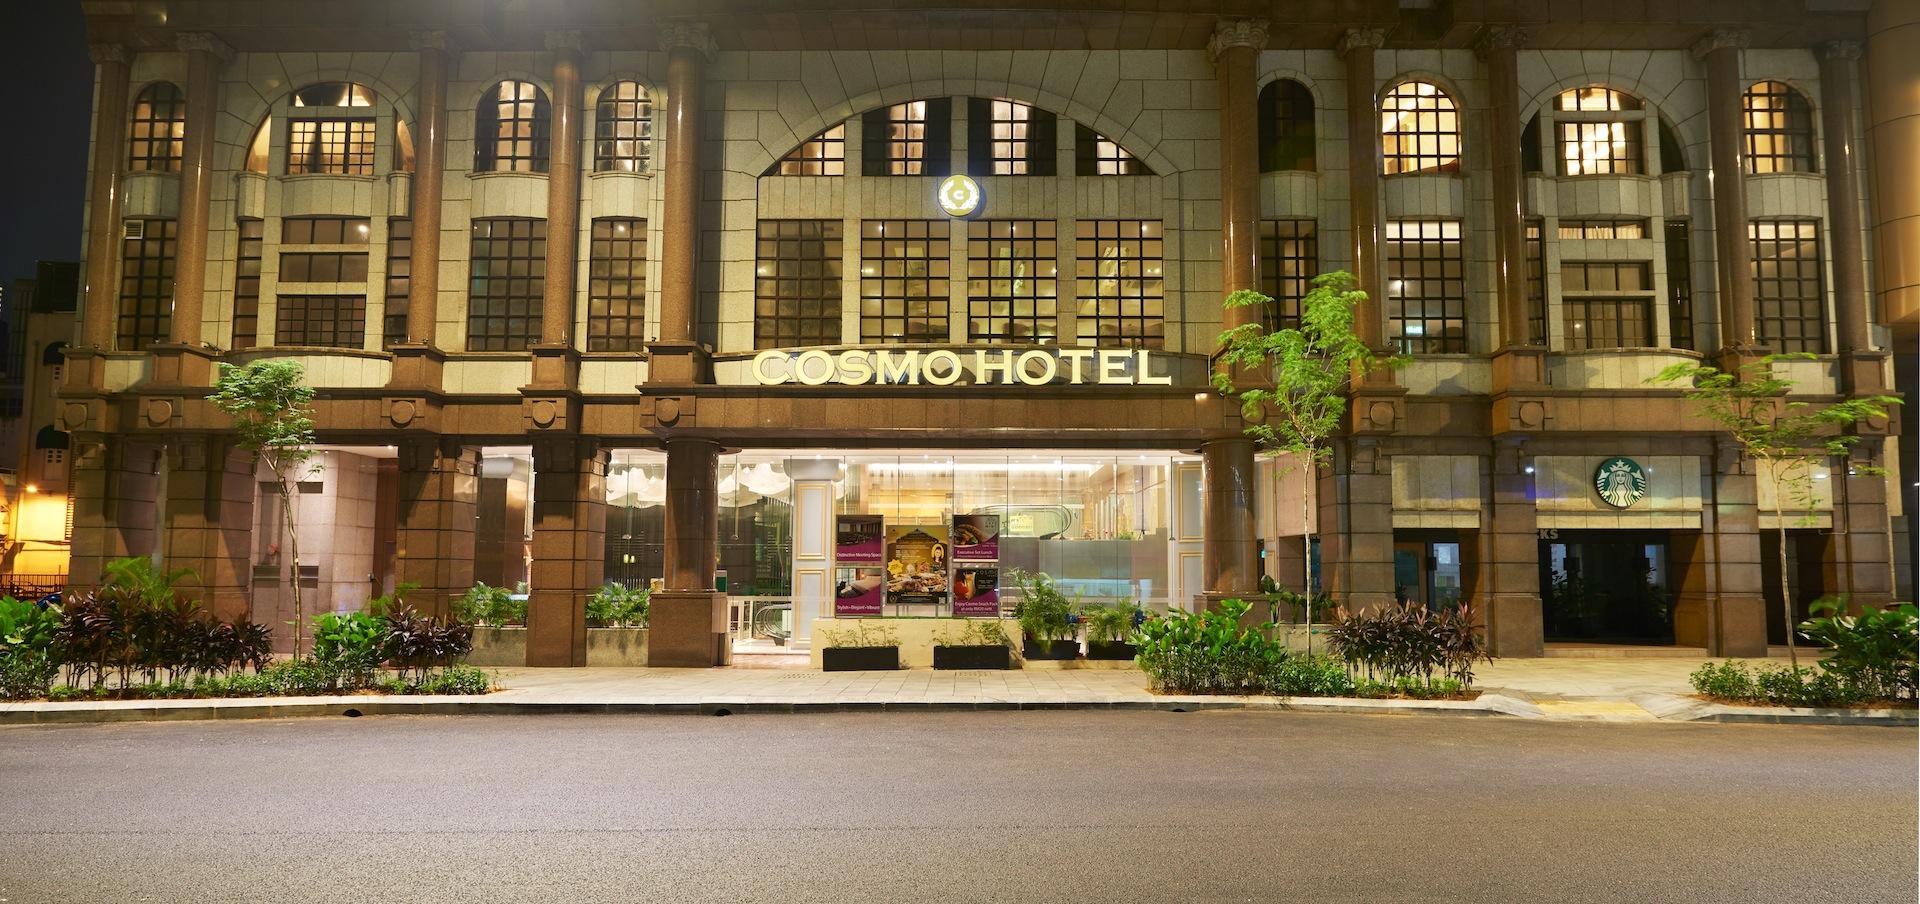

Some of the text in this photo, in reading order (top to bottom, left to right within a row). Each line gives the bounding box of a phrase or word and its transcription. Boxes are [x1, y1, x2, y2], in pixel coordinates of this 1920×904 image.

[752, 348, 1172, 386] COSMO HOTEL
[1536, 528, 1559, 540] KS
